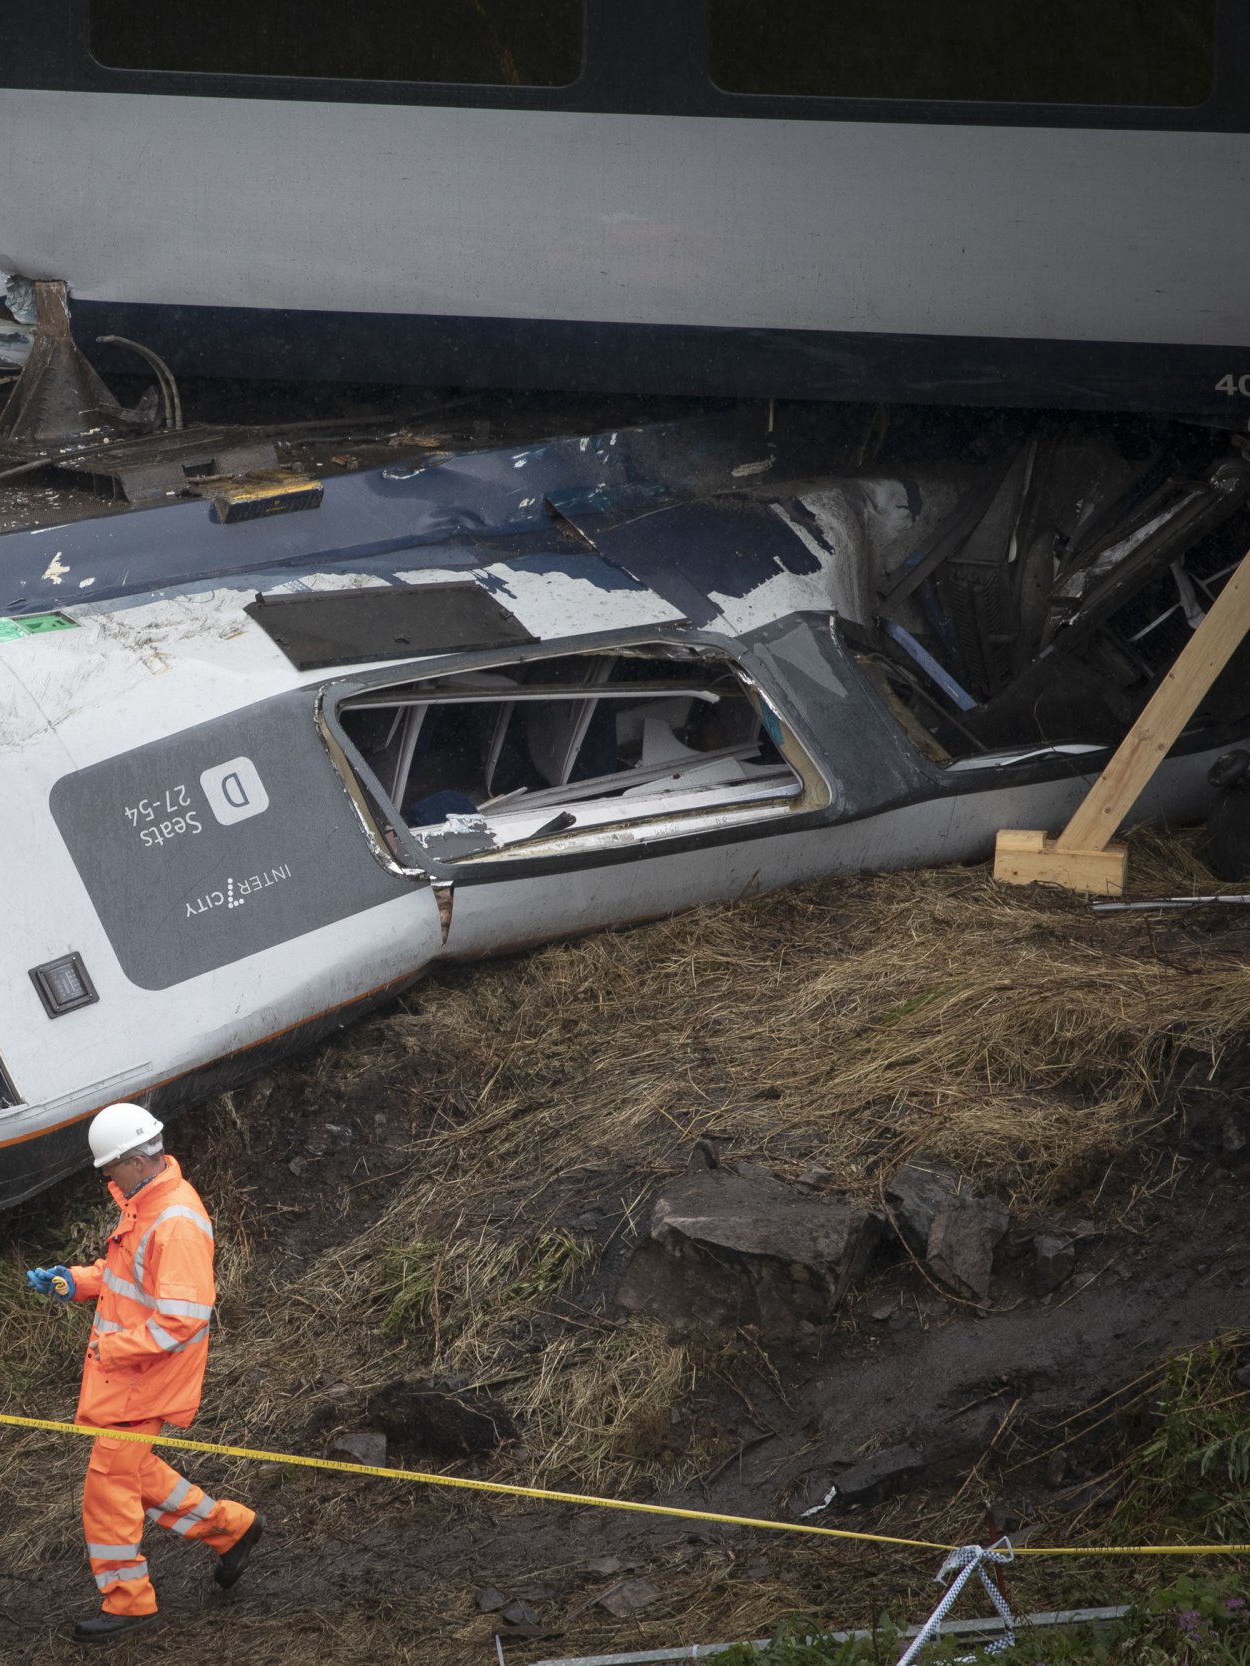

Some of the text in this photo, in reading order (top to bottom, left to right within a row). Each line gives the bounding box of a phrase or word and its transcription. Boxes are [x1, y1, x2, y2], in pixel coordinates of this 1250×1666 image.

[124, 785, 190, 826] 27-54
[221, 772, 250, 808] D
[140, 811, 202, 846] Seats
[185, 864, 291, 917] INTER CITY
